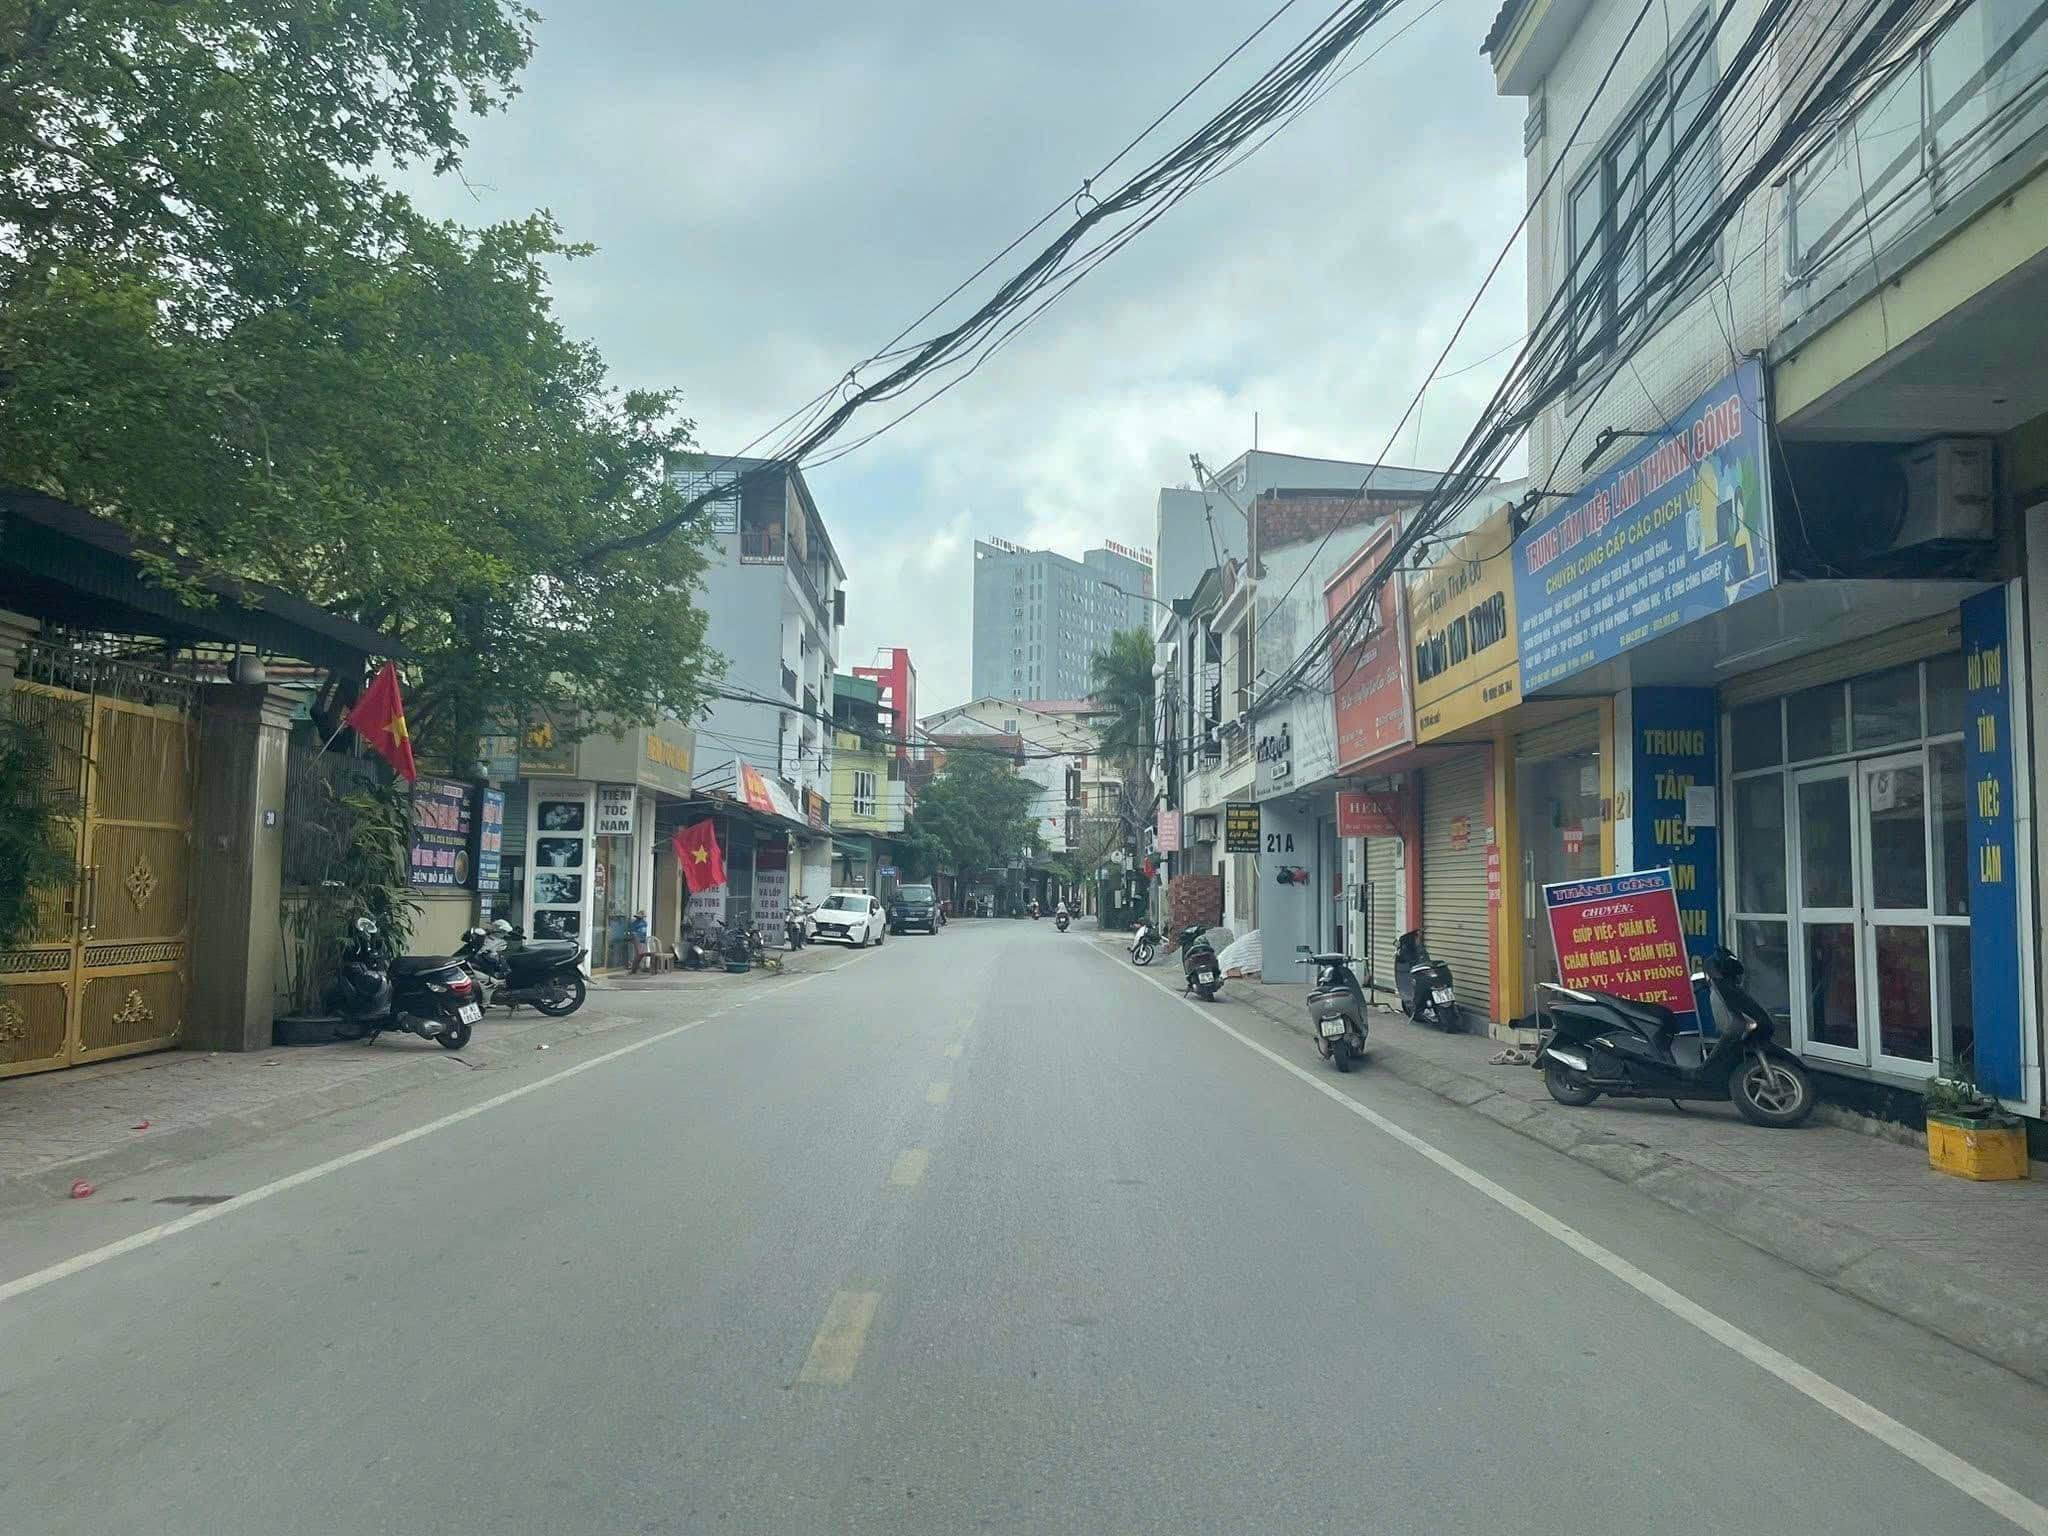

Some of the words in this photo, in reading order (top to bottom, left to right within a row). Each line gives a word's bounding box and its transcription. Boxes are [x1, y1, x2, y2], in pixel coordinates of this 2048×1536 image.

[1692, 394, 1743, 462] CÔNG
[1578, 548, 1605, 576] CUNG
[1605, 526, 1627, 562] CẤP
[1628, 515, 1651, 546] CÁC
[1653, 498, 1683, 529] DỊCH
[1644, 729, 1704, 756] TRUNG
[1977, 709, 1996, 753] TÌM
[1977, 772, 1999, 825] VIỆC
[599, 820, 629, 832] NAM
[1654, 814, 1695, 850] VIỆC
[1267, 833, 1281, 852] 21
[1285, 833, 1295, 852] A
[1980, 838, 2001, 882] LÀM
[1553, 881, 1613, 901] THÀNH
[1617, 876, 1664, 892] CÔNG
[1573, 924, 1593, 944] GIÚP
[1618, 918, 1645, 938] CHĂM
[1646, 915, 1658, 934] BÉ
[1563, 951, 1589, 970] CHĂM
[1590, 949, 1608, 967] ÔNG
[1629, 944, 1655, 962] CHĂM
[1655, 940, 1677, 961] VIỆN
[1592, 973, 1608, 989] VỤ
[1616, 968, 1643, 984] VĂN
[1644, 965, 1684, 981] PHÒNG
